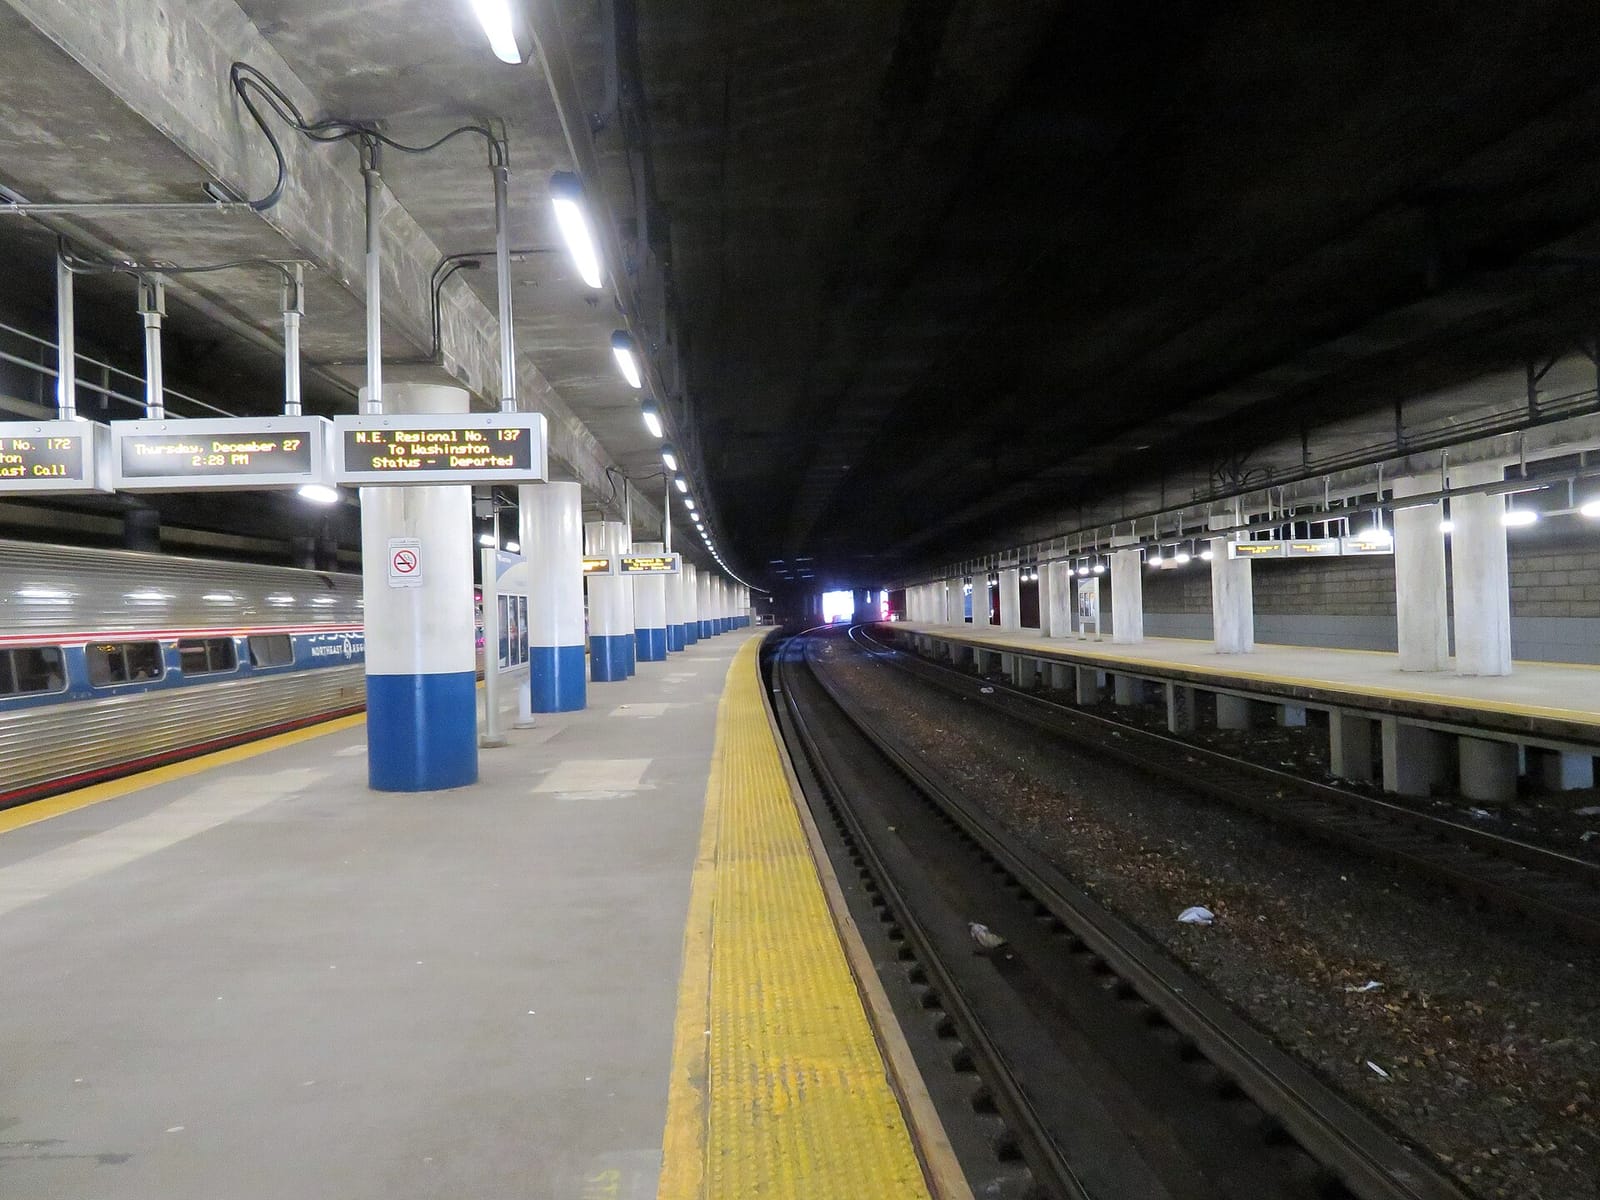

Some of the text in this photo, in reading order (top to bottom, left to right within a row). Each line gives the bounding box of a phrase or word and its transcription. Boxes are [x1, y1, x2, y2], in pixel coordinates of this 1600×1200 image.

[356, 429, 521, 443] N.E. Regional No. 137
[13, 439, 36, 450] No.
[47, 438, 72, 450] 172
[134, 439, 301, 456] Thursday, December 27
[388, 443, 490, 455] To Washington
[191, 453, 249, 467] 2:28 PM
[372, 456, 421, 469] Status
[449, 455, 514, 467] Departed
[33, 464, 67, 476] Call
